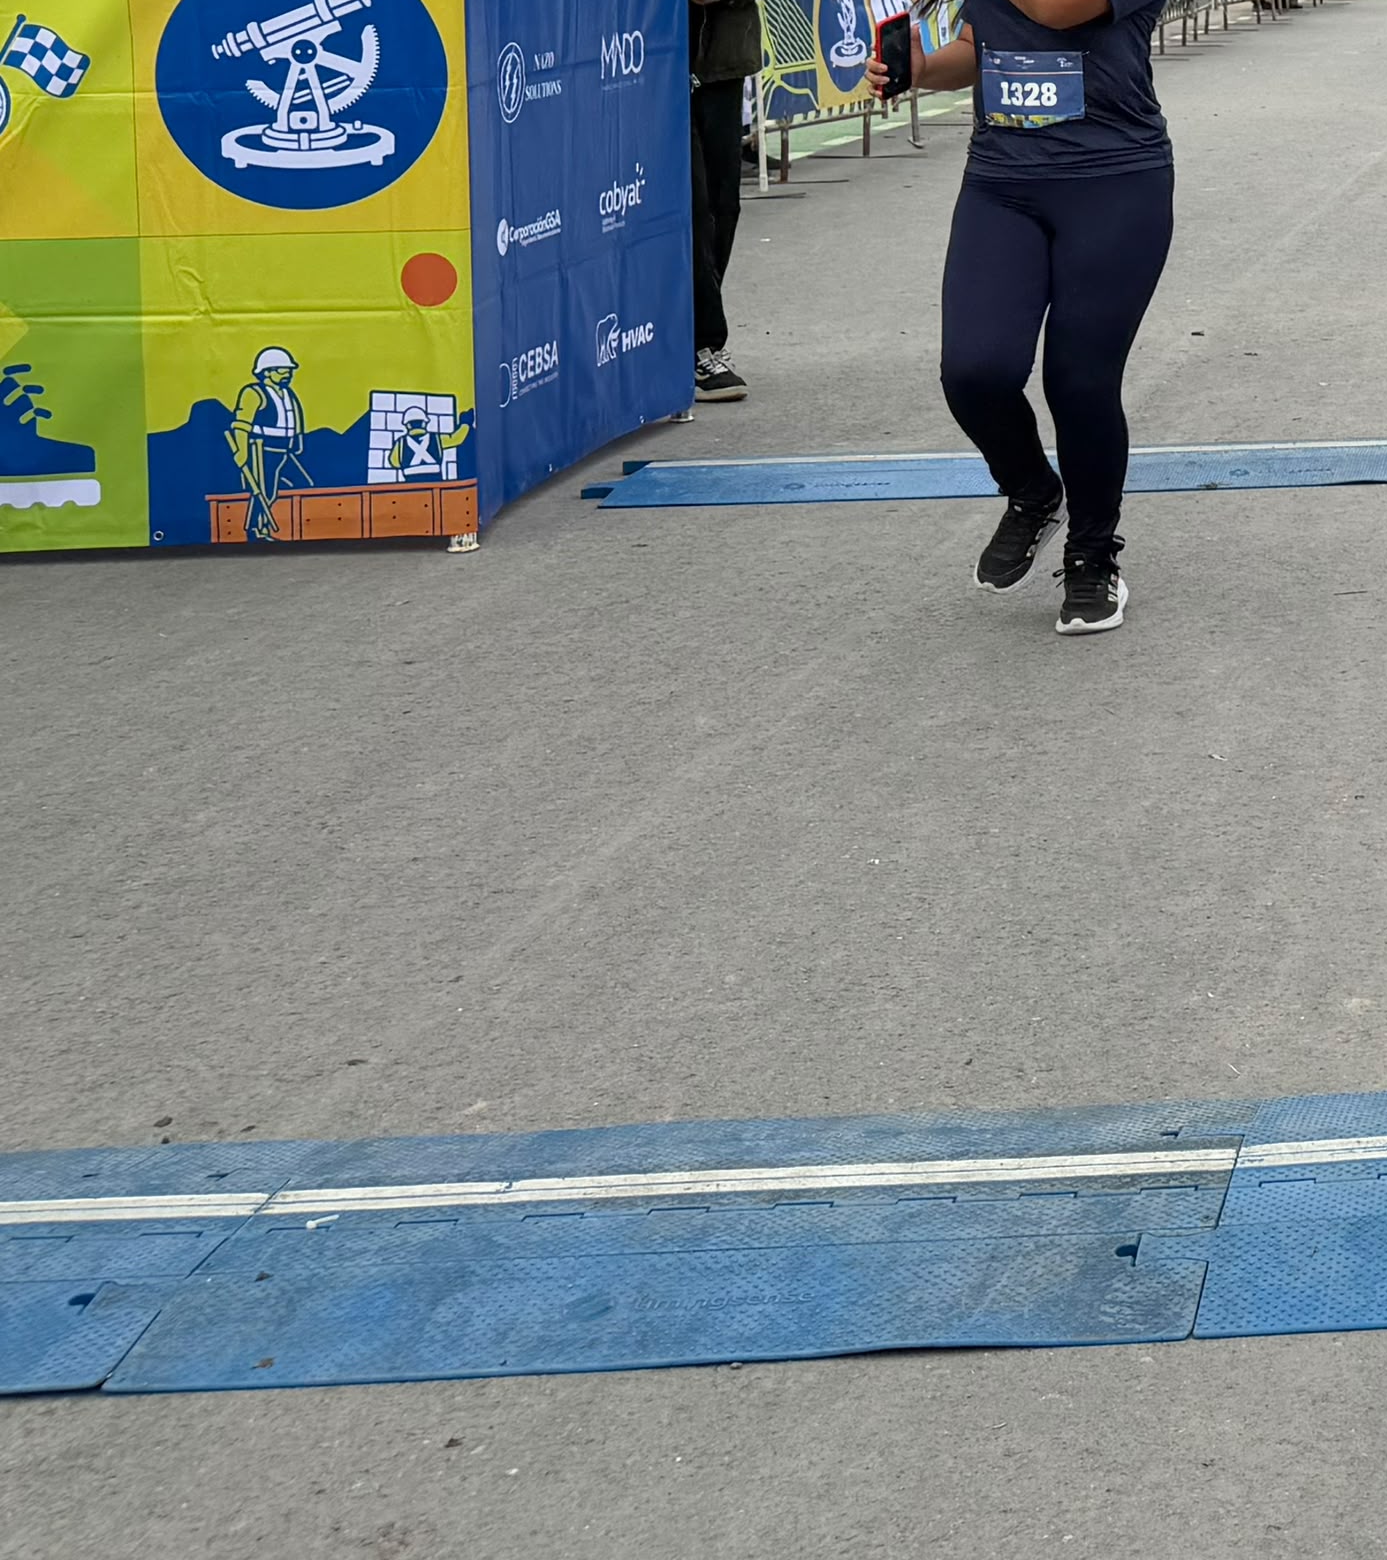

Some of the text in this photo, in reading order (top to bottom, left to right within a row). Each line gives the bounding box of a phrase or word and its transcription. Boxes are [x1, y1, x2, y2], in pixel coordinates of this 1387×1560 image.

[525, 79, 562, 102] SOLUTIONS
[1000, 81, 1058, 107] 1328
[599, 179, 645, 217] cobyat
[622, 322, 654, 353] HVAC
[518, 341, 559, 383] CEBSA
